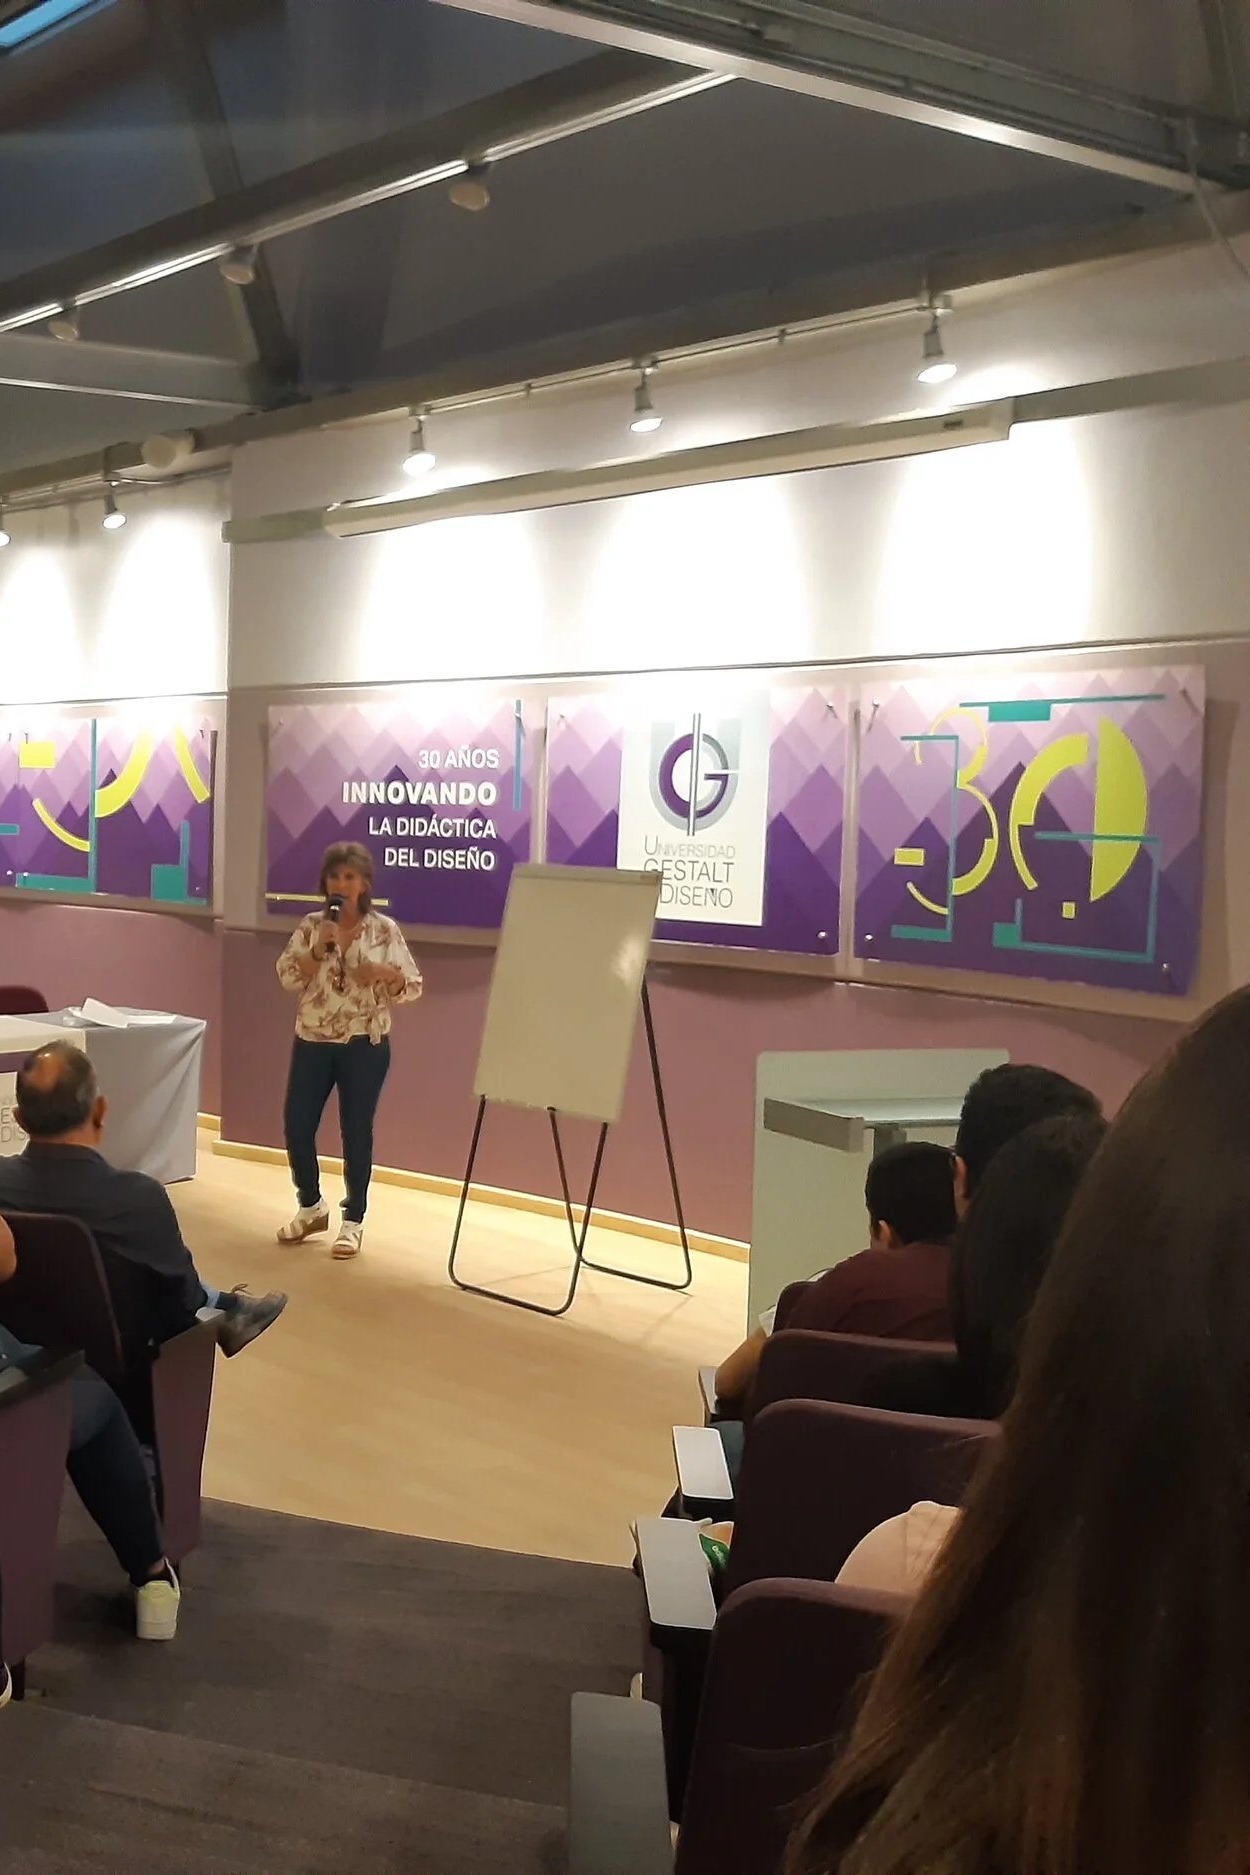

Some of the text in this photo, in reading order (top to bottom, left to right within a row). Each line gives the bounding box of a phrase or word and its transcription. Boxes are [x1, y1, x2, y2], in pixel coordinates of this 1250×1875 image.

[418, 744, 499, 769] 30 AÑOS
[342, 780, 498, 806] INNOVANDO
[368, 813, 497, 839] LA DIDÁCTICA
[384, 846, 496, 871] DEL DISEÑO
[644, 835, 736, 860] UNIVERSIDAD
